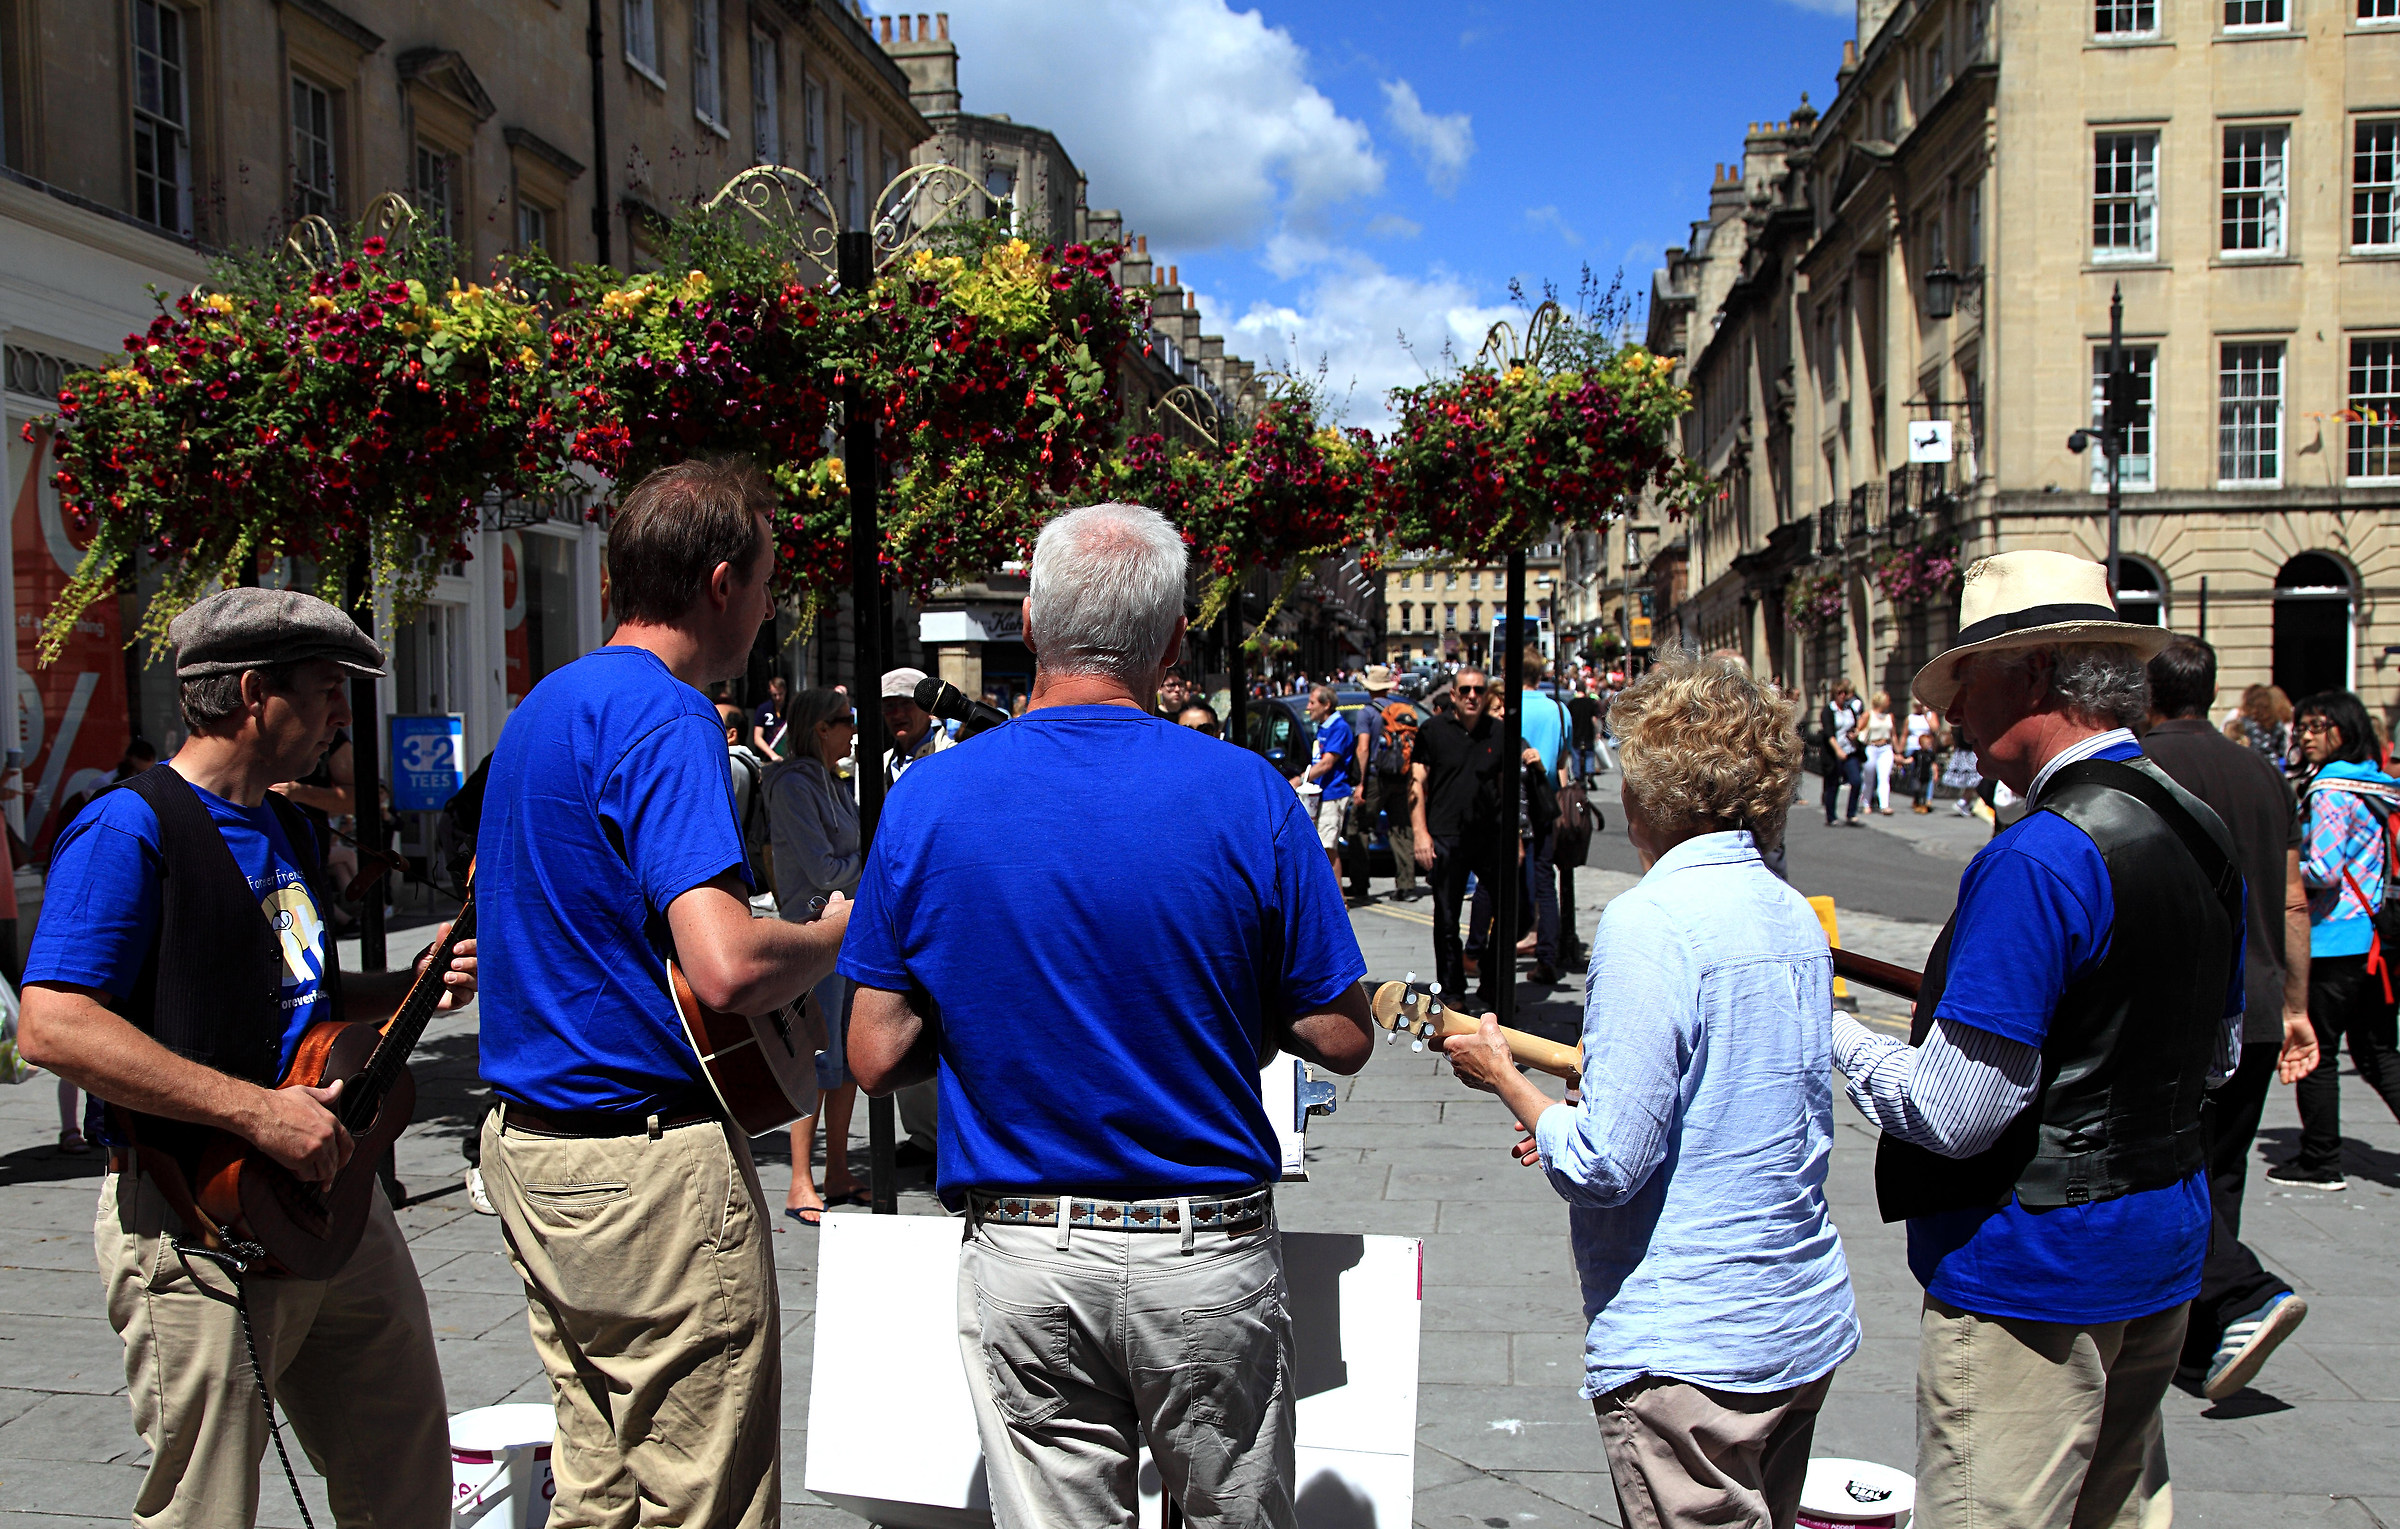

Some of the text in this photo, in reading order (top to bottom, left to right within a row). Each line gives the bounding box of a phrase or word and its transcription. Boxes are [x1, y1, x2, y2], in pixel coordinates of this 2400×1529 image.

[764, 713, 775, 726] 2
[402, 735, 423, 771] 3
[432, 737, 455, 770] 2
[409, 774, 450, 788] TEES
[246, 868, 306, 891] Forer Frien
